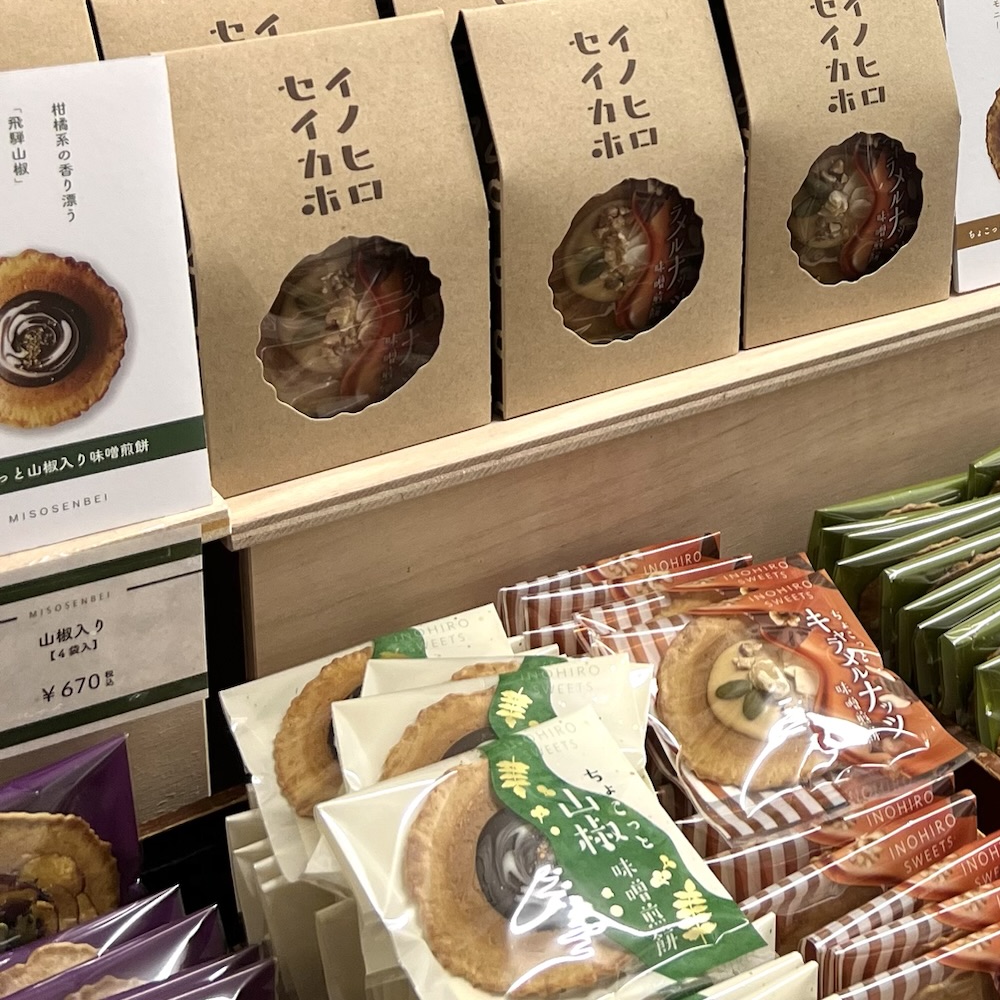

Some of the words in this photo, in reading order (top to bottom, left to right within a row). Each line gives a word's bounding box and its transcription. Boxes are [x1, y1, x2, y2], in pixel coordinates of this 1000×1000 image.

[570, 31, 625, 160] セイカホ
[608, 25, 659, 149] イノヒロ
[8, 107, 30, 183] 「飛騨山椒」
[278, 75, 341, 217] セイカホ
[325, 67, 383, 206] イノヒロ
[52, 102, 77, 223] 柑橘系の香り漂う
[9, 493, 108, 523] MISOSENBEI
[723, 560, 789, 581] INOHIRO
[737, 571, 788, 584] SWEETS
[748, 580, 813, 602] INOHIRO
[29, 591, 110, 618] MISOSENBEI
[764, 591, 814, 608] SWEETS
[39, 619, 103, 647] 山椒入り
[805, 608, 905, 739] キャラメルナッツ
[558, 788, 629, 855] 山椒
[584, 769, 654, 849] ちょこっと
[866, 789, 934, 828] INOHIRO
[888, 813, 957, 861] INOHIRO
[903, 836, 954, 875] SWEETS
